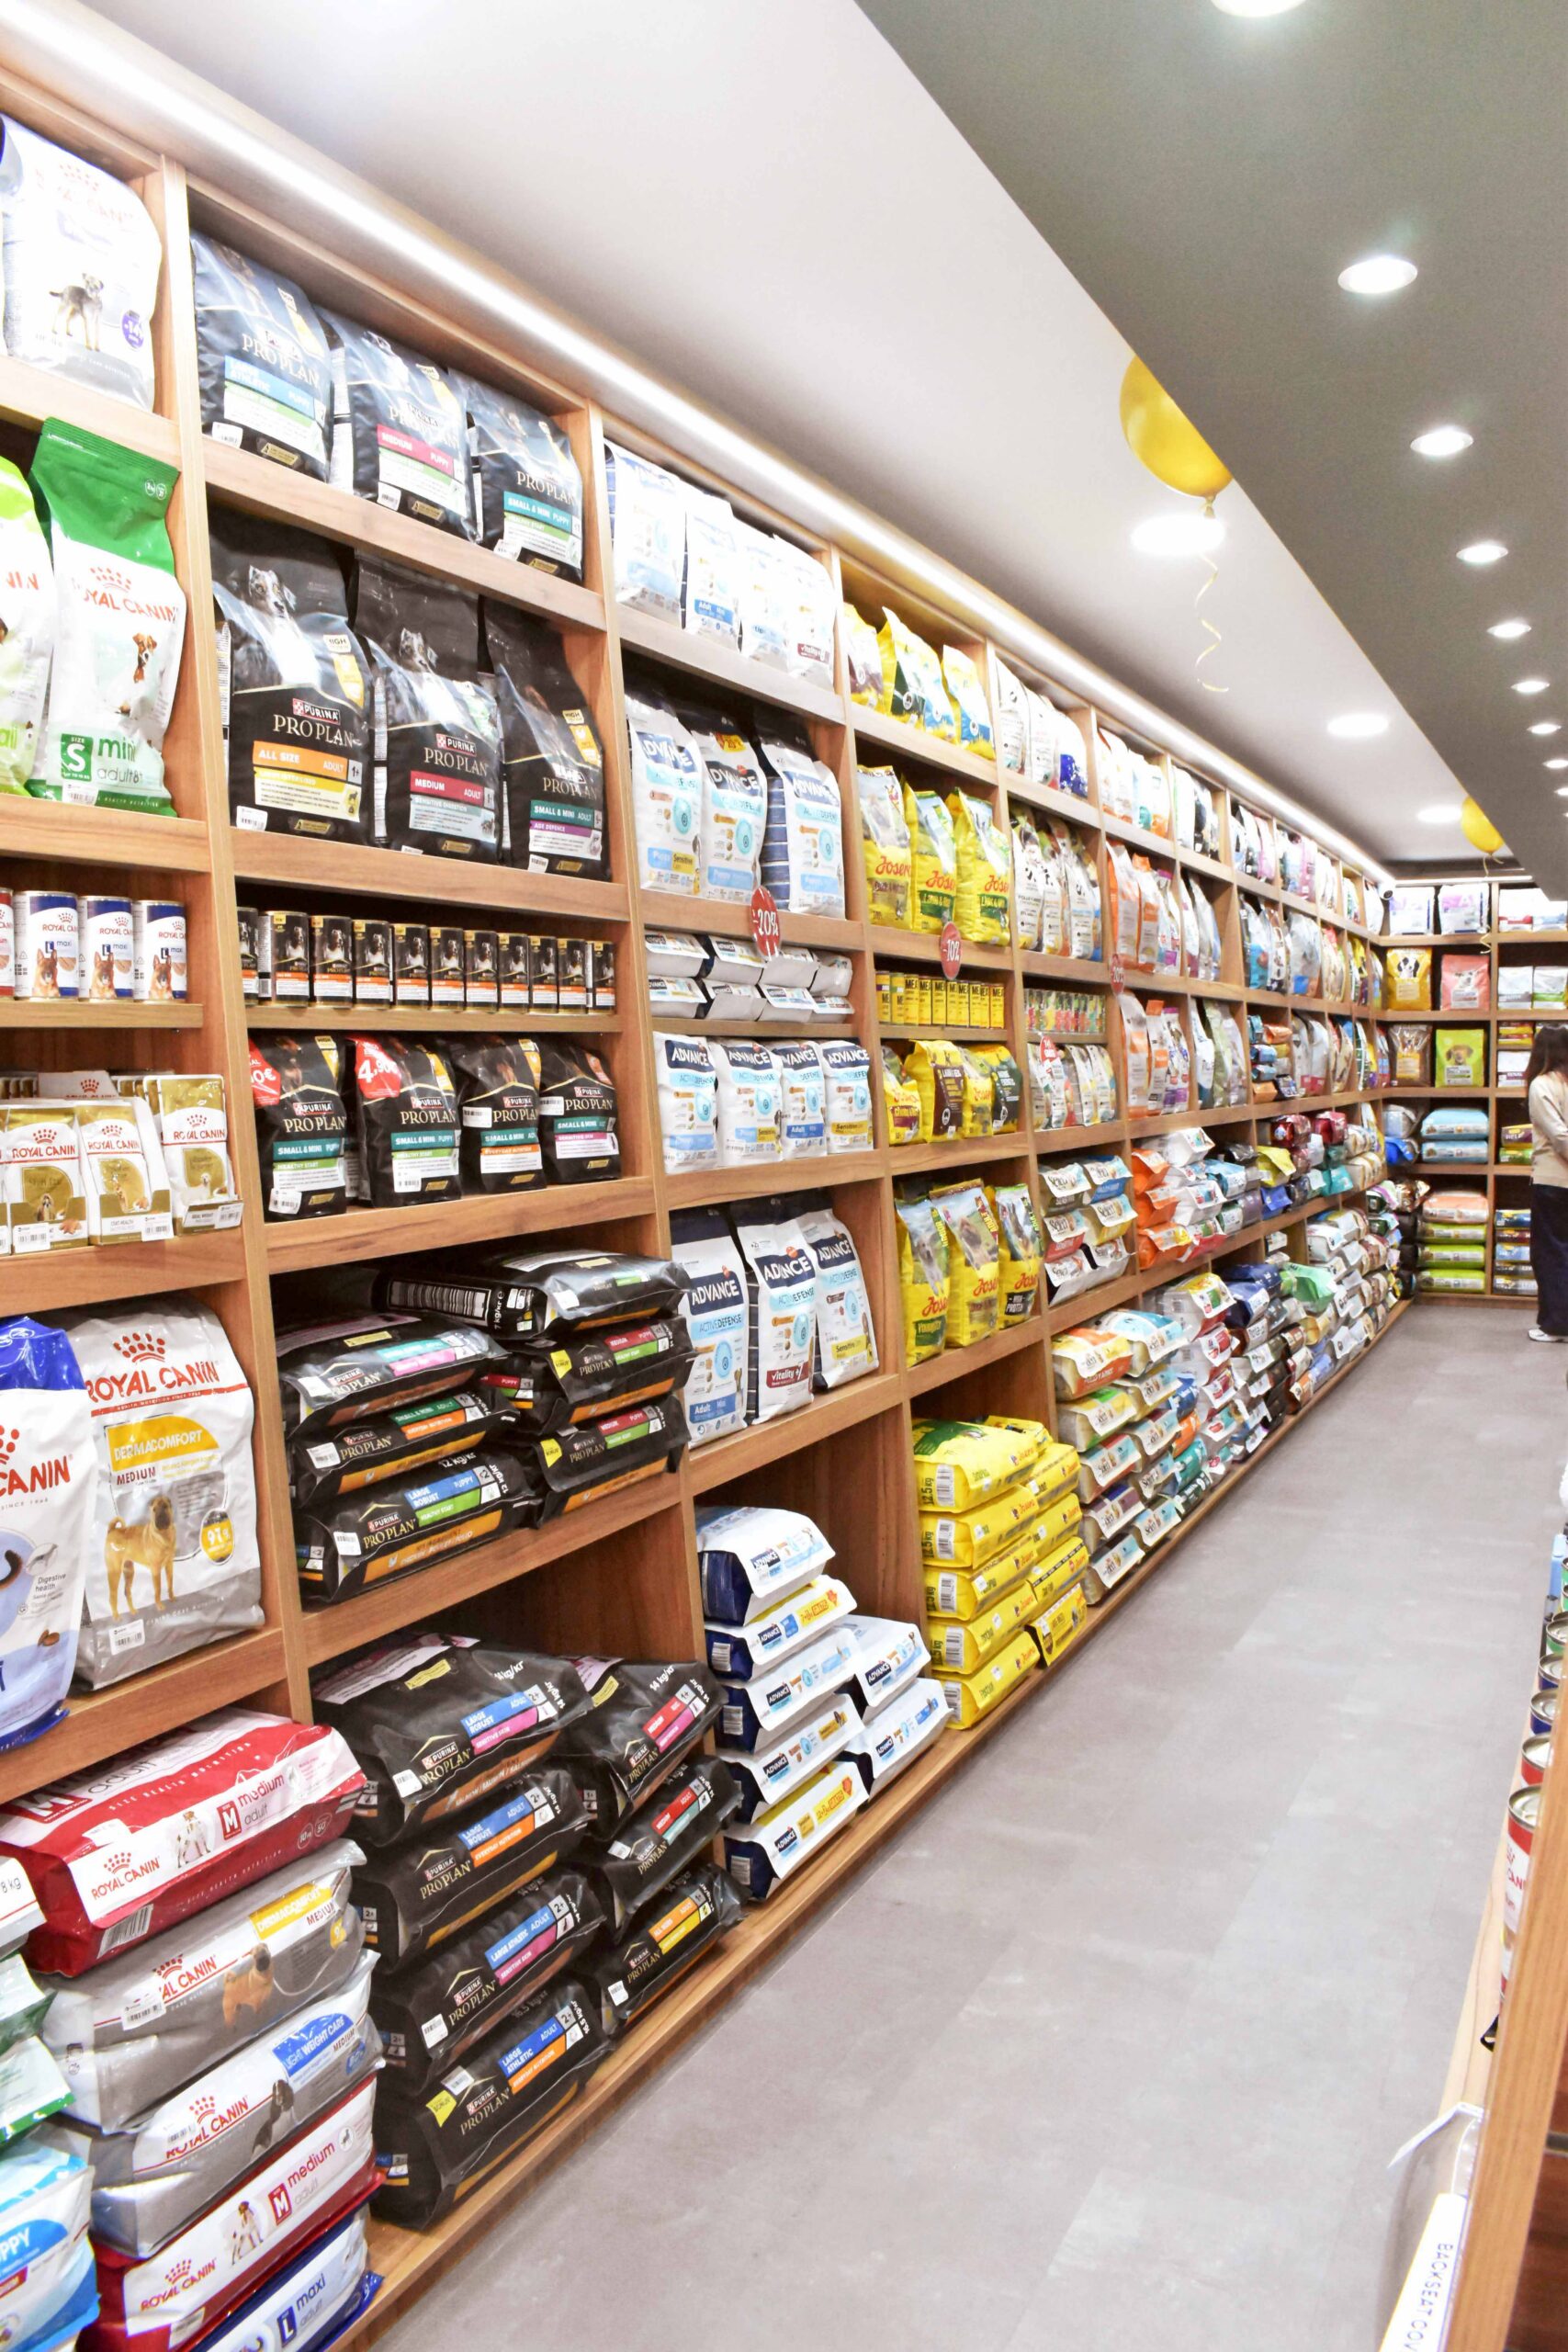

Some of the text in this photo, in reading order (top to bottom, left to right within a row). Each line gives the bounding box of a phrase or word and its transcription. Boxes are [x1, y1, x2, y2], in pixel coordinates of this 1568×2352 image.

[516, 470, 545, 493] PRO
[304, 706, 339, 721] PURINA
[273, 715, 354, 749] PRO PLAN
[98, 737, 137, 762] mini
[446, 738, 476, 753] PURINA
[66, 743, 86, 774] S
[258, 749, 344, 774] ALL SIZE ADULT
[423, 747, 488, 777] PRO PLAN
[414, 778, 482, 800] MEDIUM ADULT
[534, 805, 592, 822] SMALL MINI ADULT
[42, 922, 66, 933] ROYAL
[99, 927, 122, 935] ROYAL
[158, 932, 178, 940] ROYAL
[57, 940, 73, 948] maxi
[671, 1046, 710, 1067] ADVANCE
[828, 1048, 869, 1065] ADVANCE
[511, 1097, 532, 1106] PURINA
[581, 1088, 601, 1096] PURINA
[565, 1098, 612, 1111] PRO PLAN
[284, 1115, 345, 1134] PRO PLAN
[400, 1109, 457, 1125] PRO PLAN
[493, 1109, 518, 1123] PRO
[558, 1121, 581, 1129] SMALL
[200, 1128, 226, 1140] CANIN
[396, 1137, 419, 1146] SMALL
[485, 1134, 508, 1142] SMALL
[12, 1144, 75, 1159] ROYAL CANIN
[88, 1139, 140, 1150] ROYAL CANIN
[278, 1147, 303, 1155] SMALL
[692, 1280, 739, 1306] ADVANCE
[86, 1361, 220, 1403] ROYAL CANIN
[336, 1369, 364, 1383] PURINA
[352, 1372, 382, 1392] PLAN
[114, 1430, 203, 1462] DERMACOMFORT
[340, 1436, 392, 1461] PRO PLAN
[570, 1451, 588, 1464] PRO
[117, 1466, 157, 1486] MEDIUM
[454, 1476, 474, 1488] PUPPY
[409, 1487, 431, 1500] LARGE
[414, 1492, 440, 1508] ROBUST
[374, 1513, 400, 1527] PURINA
[364, 1521, 415, 1548] PRO PLAN
[35, 1582, 56, 1593] health
[38, 1573, 67, 1585] Digestive
[761, 1627, 781, 1643] ADVANCE
[867, 1664, 890, 1683] ADVANCE
[769, 1686, 790, 1704] ADVANCE
[469, 1715, 495, 1735] ROBUST
[432, 1745, 457, 1763] PURINA
[444, 1748, 471, 1775] PLAN
[766, 1756, 788, 1776] ADVANCE
[87, 1758, 157, 1795] adult
[238, 1774, 286, 1808] medium
[530, 1792, 541, 1804] 2+
[108, 1794, 138, 1811] SIZE
[507, 1803, 525, 1819] ADULT
[222, 1808, 238, 1834] M
[244, 1804, 269, 1826] adult
[777, 1831, 797, 1850] ADVANCE
[430, 1857, 455, 1874] PURINA
[8, 1875, 22, 1892] kg
[91, 1858, 161, 1901] ROYAL CANIN
[420, 1863, 471, 1900] PRO PLAN
[306, 1902, 337, 1926] MEDIUM
[553, 1900, 565, 1914] 2+
[530, 1912, 551, 1932] ADULT
[178, 1955, 217, 1989] CANIN
[461, 1979, 482, 1999] PURINA
[448, 1984, 497, 2026] PRO PLAN
[561, 2010, 574, 2025] 2+
[302, 2016, 346, 2057] WEIGHT CARE
[333, 2028, 356, 2053] MEDIUM
[540, 2022, 558, 2042] ADULT
[502, 2047, 523, 2067] LARGE
[506, 2048, 535, 2075] ATHLETIC
[473, 2088, 497, 2109] PURINA
[210, 2097, 250, 2132] CANIN
[460, 2093, 510, 2136] PRO PLAN
[288, 2141, 337, 2189] medium
[294, 2177, 320, 2205] adult
[273, 2193, 288, 2221] M
[141, 2260, 217, 2312] ROYAL CANIN
[296, 2273, 327, 2312] maxi
[300, 2301, 323, 2327] adult
[283, 2315, 295, 2343] L
